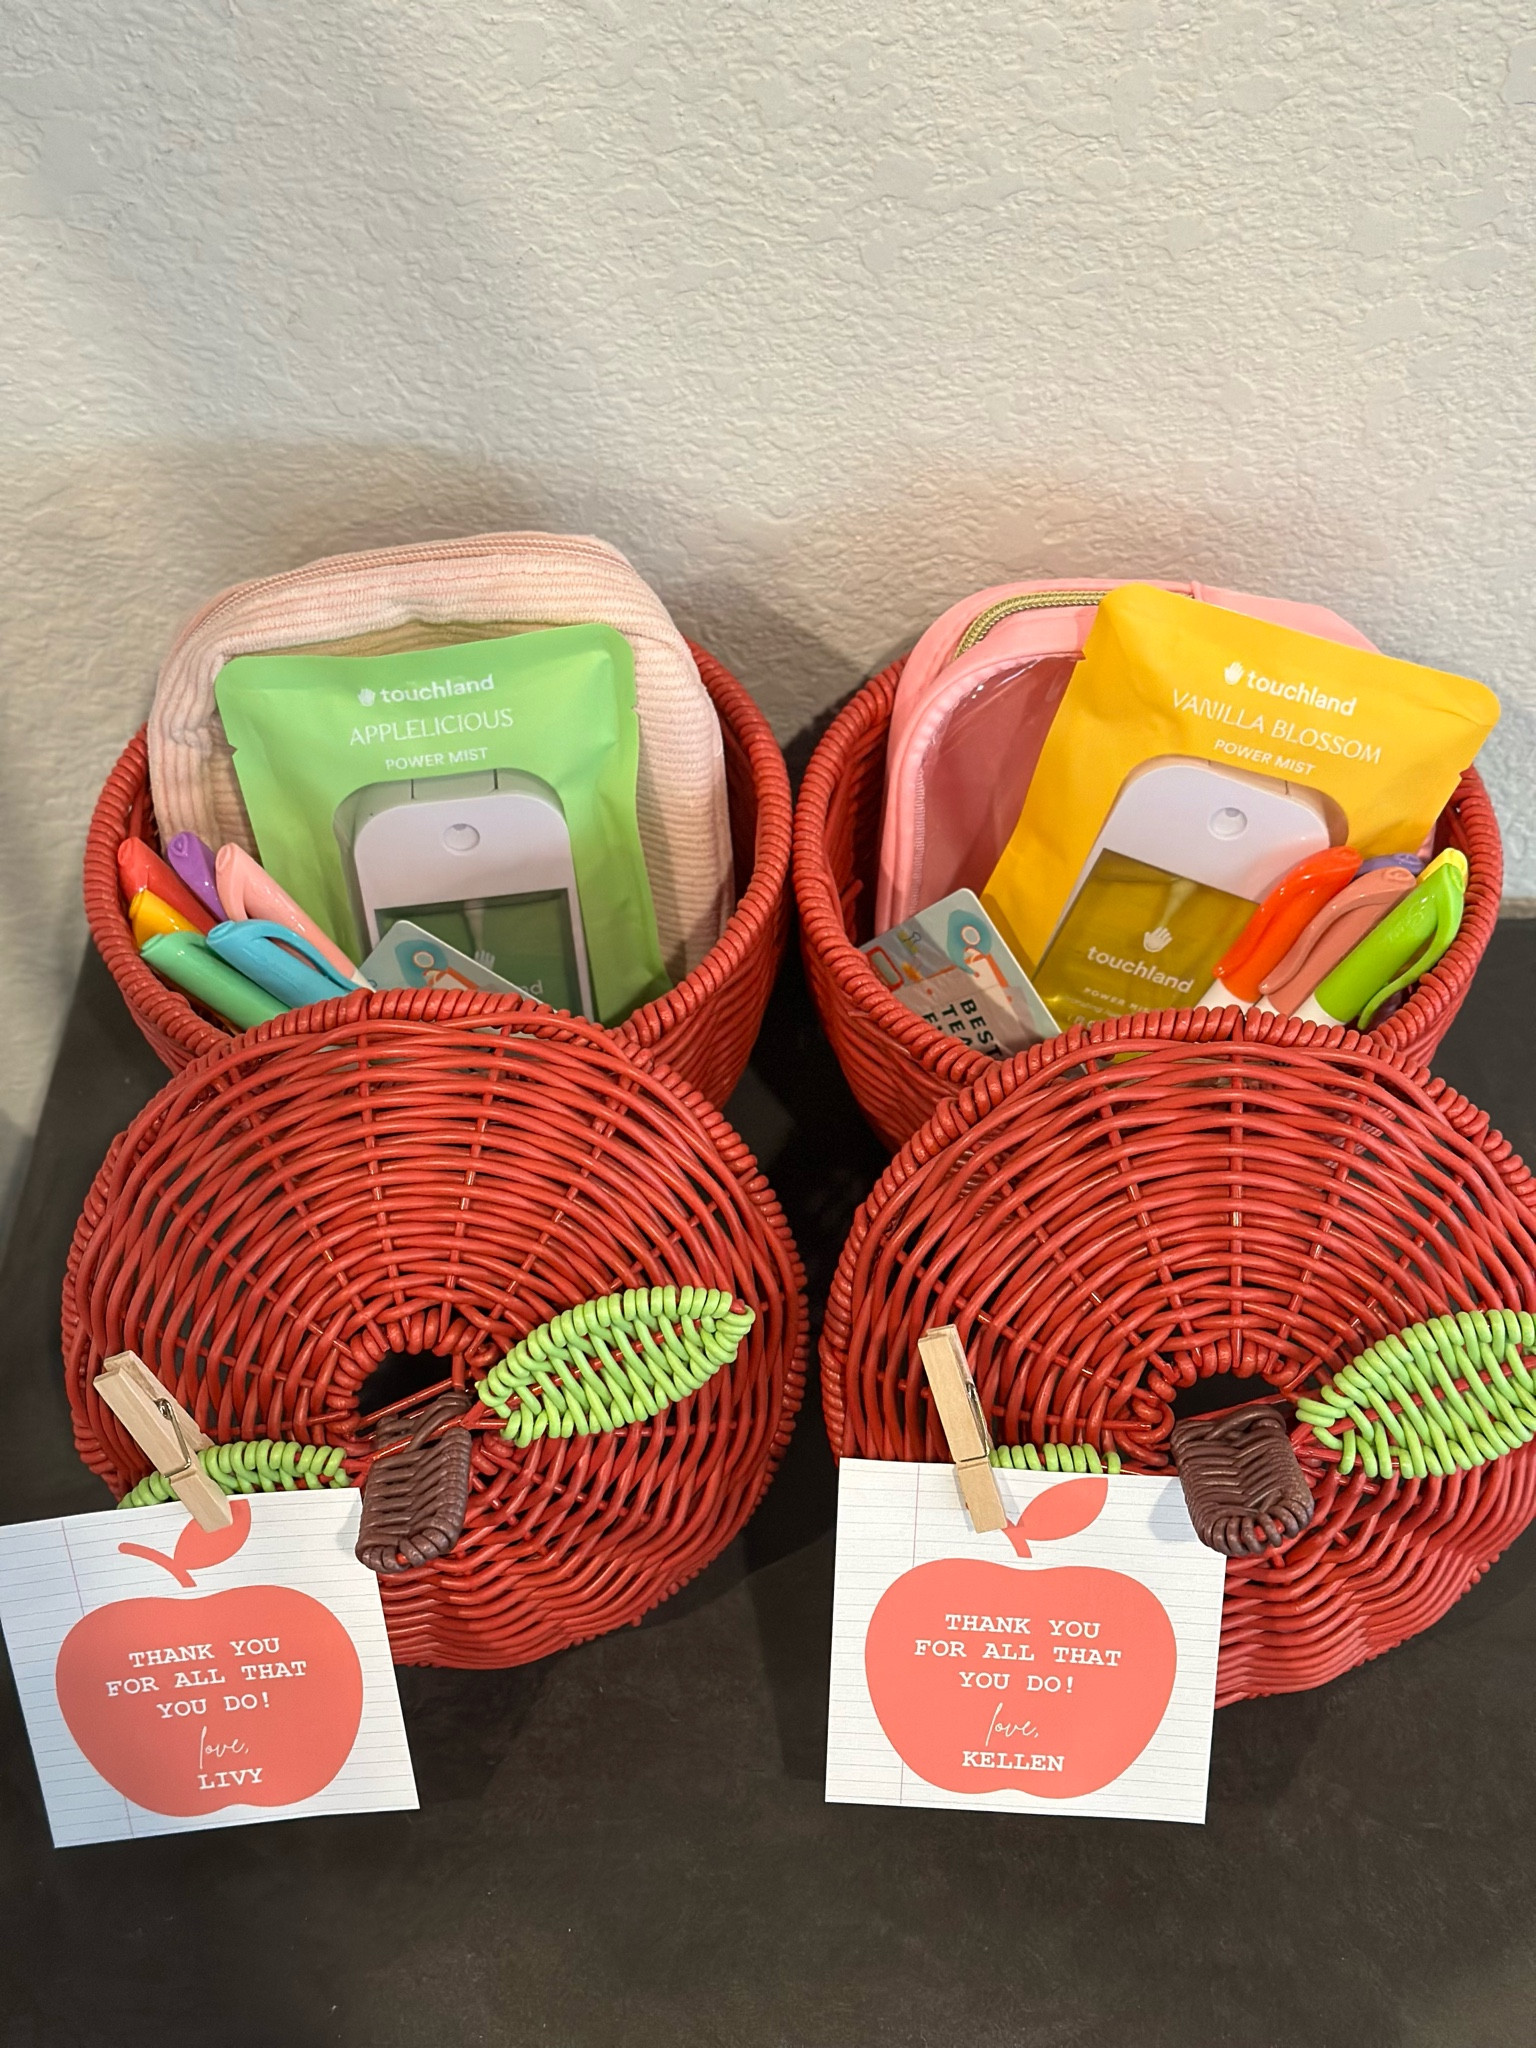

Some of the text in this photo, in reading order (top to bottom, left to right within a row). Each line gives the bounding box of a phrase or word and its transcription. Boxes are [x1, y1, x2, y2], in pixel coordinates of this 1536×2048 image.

[380, 673, 495, 704] touchland
[1247, 669, 1358, 717] touchland
[349, 708, 514, 746] APPLELICIOUS
[1172, 688, 1382, 765] VANILLA BLOSSOM
[385, 747, 488, 771] POWER MIST
[1213, 738, 1317, 776] POWER MIST
[1086, 945, 1195, 994] touchland
[1083, 986, 1127, 1007] POWER
[960, 998, 1003, 1057] BEST
[945, 1613, 1101, 1639] THANK YOU
[128, 1637, 281, 1668] THANK YOU
[914, 1639, 1122, 1667] FOR ALL THAT
[106, 1660, 307, 1697] FOR ALL THAT
[958, 1671, 1074, 1694] YOU DO!
[156, 1691, 271, 1719] YOU DO!
[985, 1702, 1040, 1747] love,
[199, 1725, 250, 1770] love,
[961, 1750, 1065, 1772] KELLEN
[197, 1767, 263, 1790] LIVY
